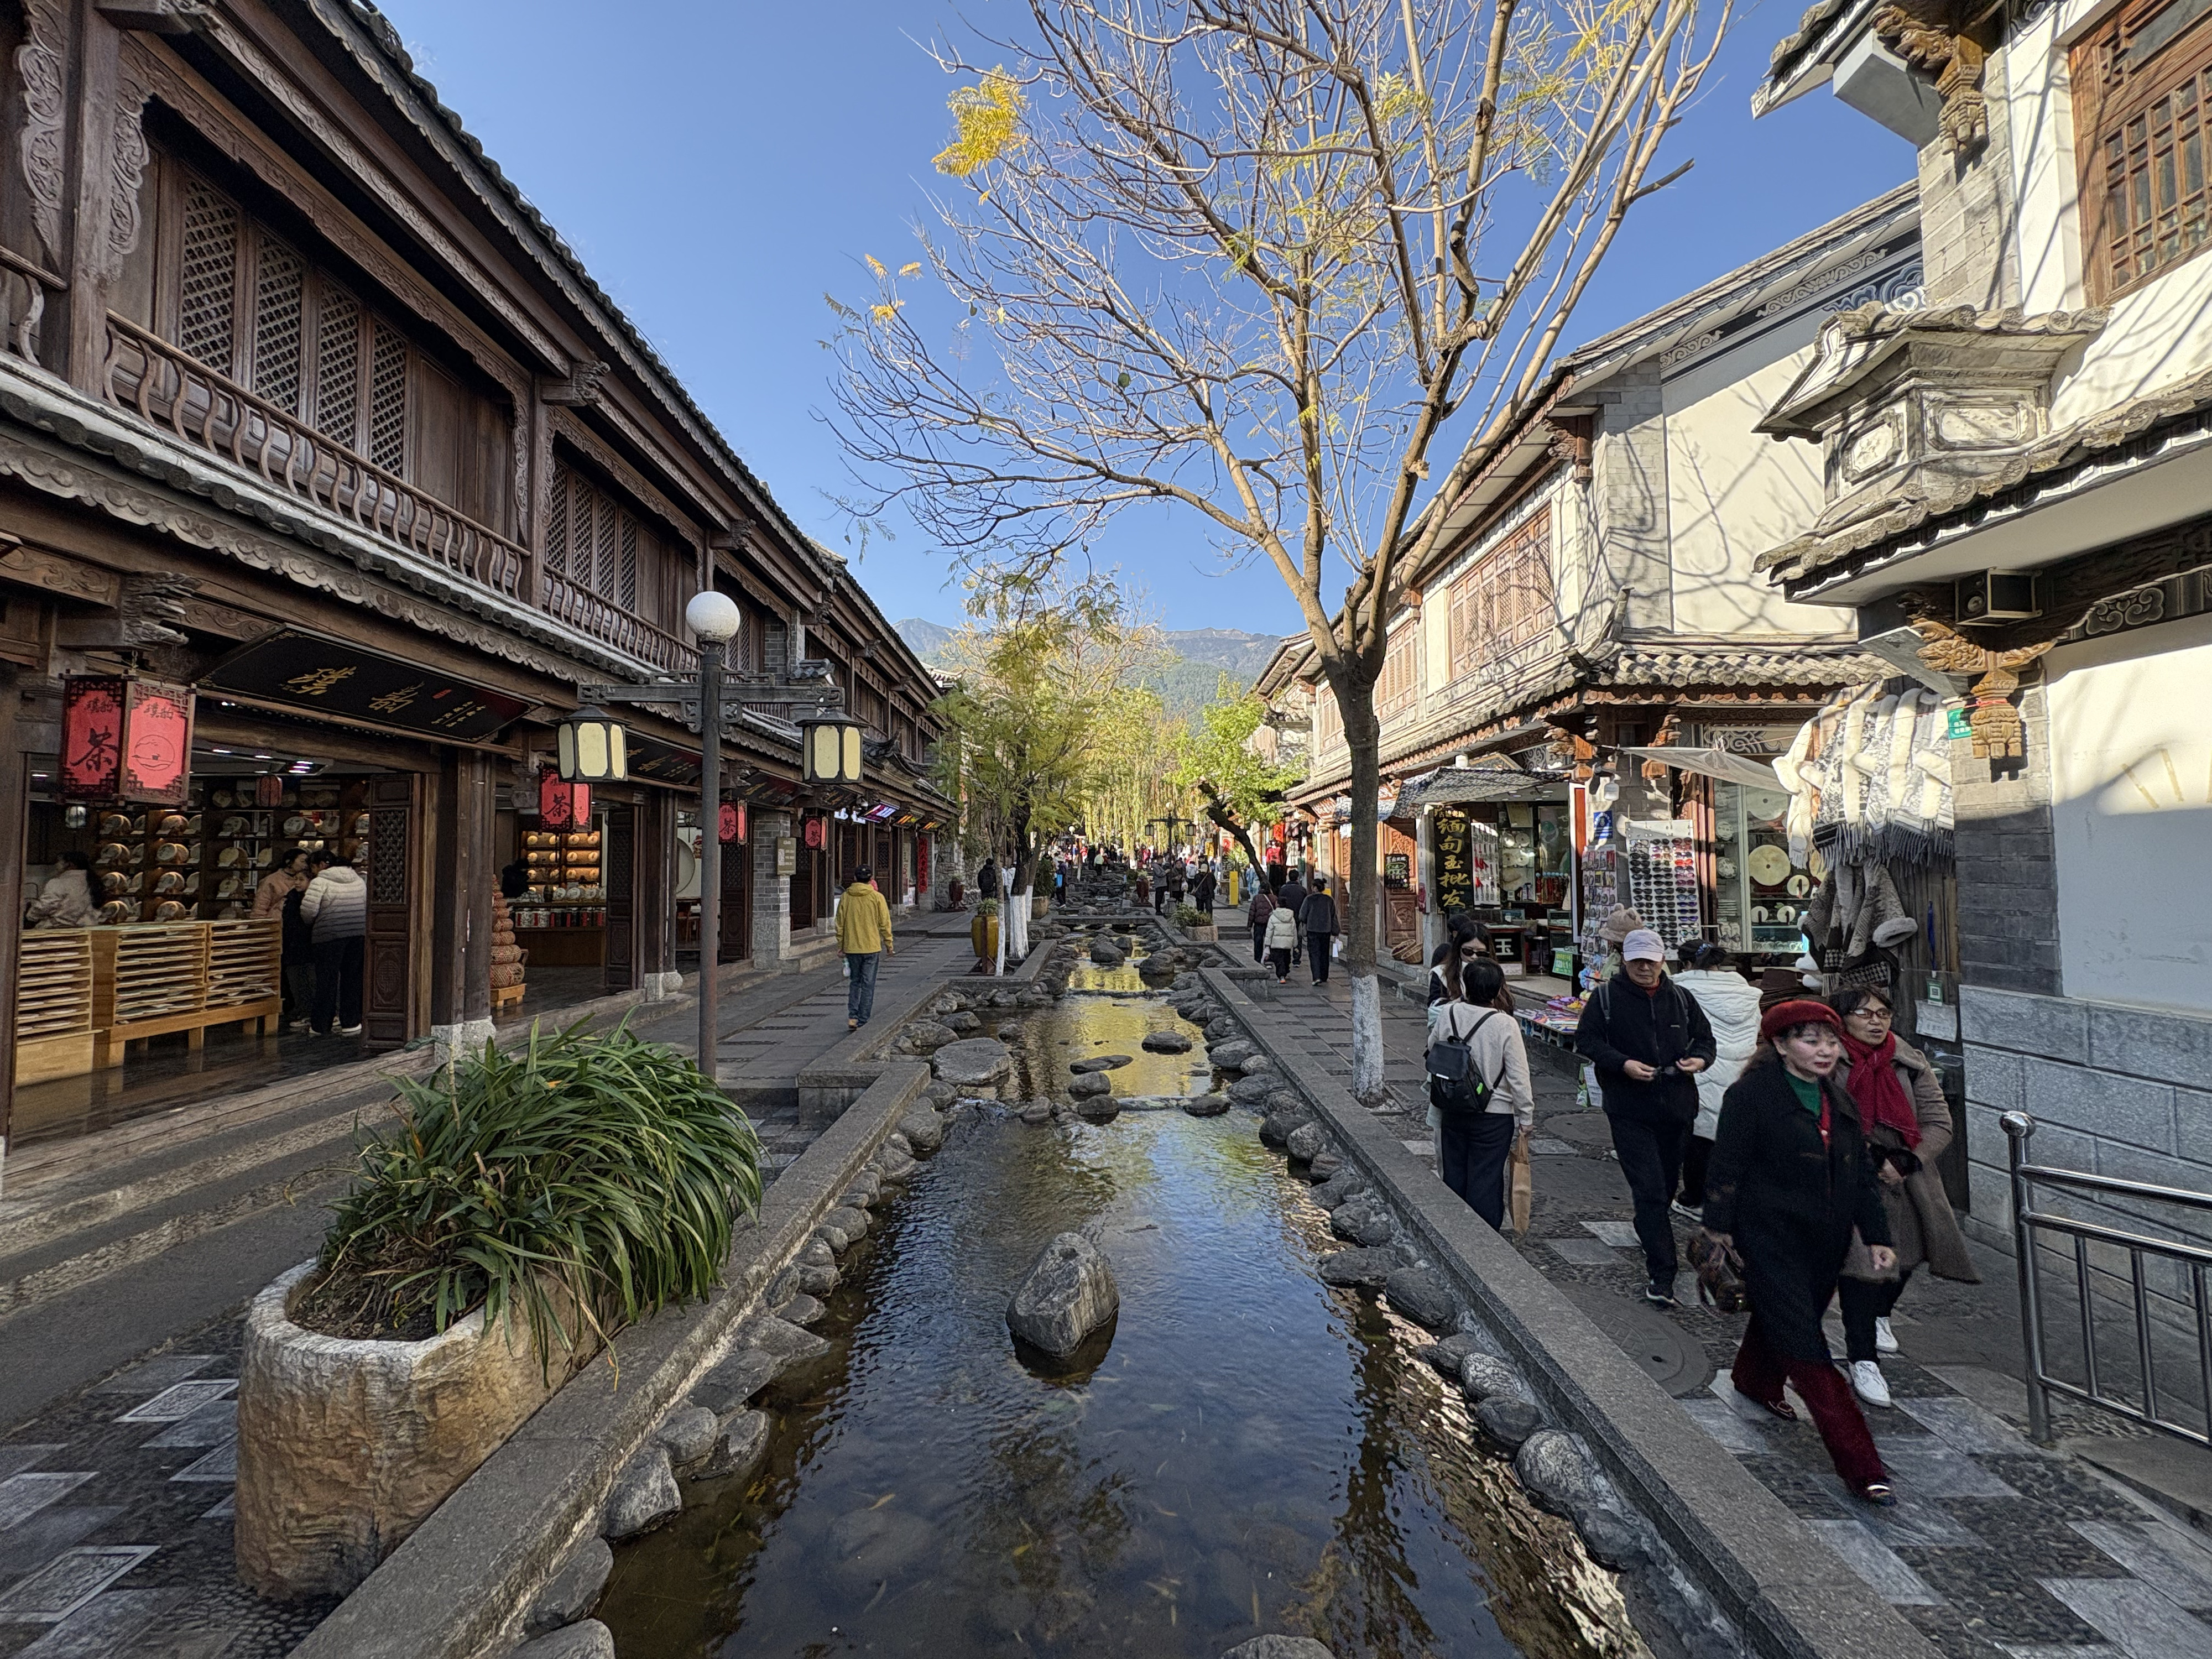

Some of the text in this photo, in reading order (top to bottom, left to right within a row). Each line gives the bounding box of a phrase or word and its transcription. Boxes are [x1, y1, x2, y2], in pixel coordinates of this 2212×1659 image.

[70, 725, 118, 772] 茶
[543, 791, 572, 817] 茶
[719, 817, 737, 835] 茶
[807, 830, 821, 843] 茶
[1436, 817, 1471, 910] 缅甸玉批发
[1494, 938, 1514, 956] 玉
